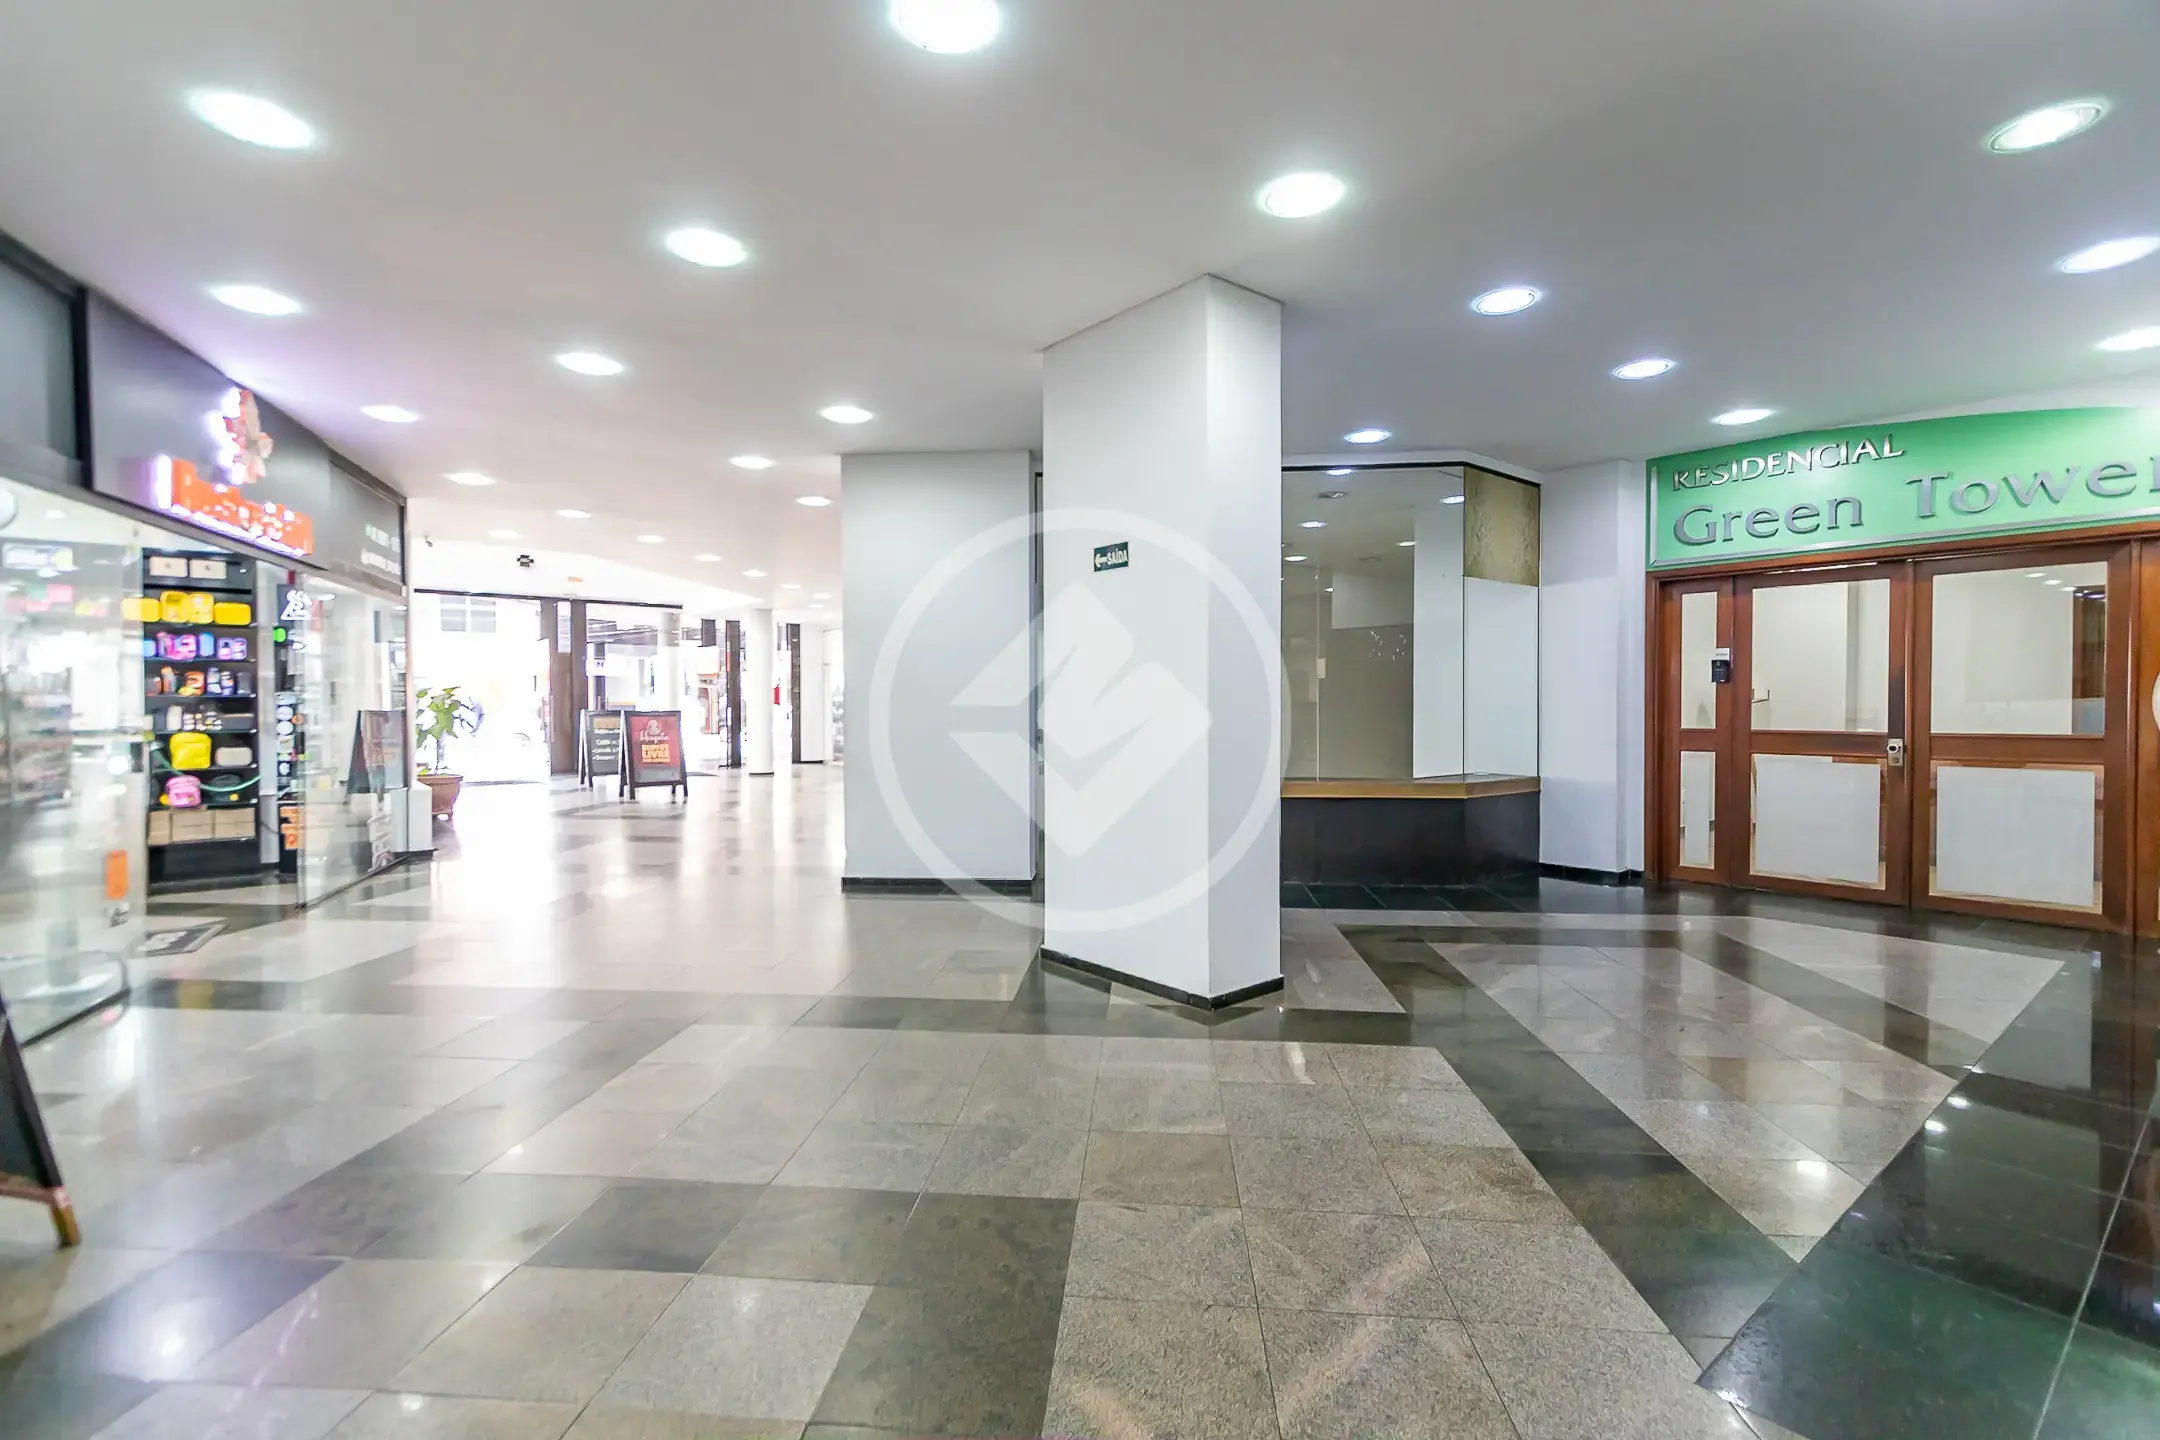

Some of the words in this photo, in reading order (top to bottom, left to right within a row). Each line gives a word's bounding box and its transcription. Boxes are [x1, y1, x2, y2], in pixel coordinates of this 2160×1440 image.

[1672, 433, 1906, 492] RESIDENCIAL
[1673, 496, 1864, 547] Green
[1107, 548, 1128, 565] SAÍDA
[642, 750, 670, 759] LIVRE
